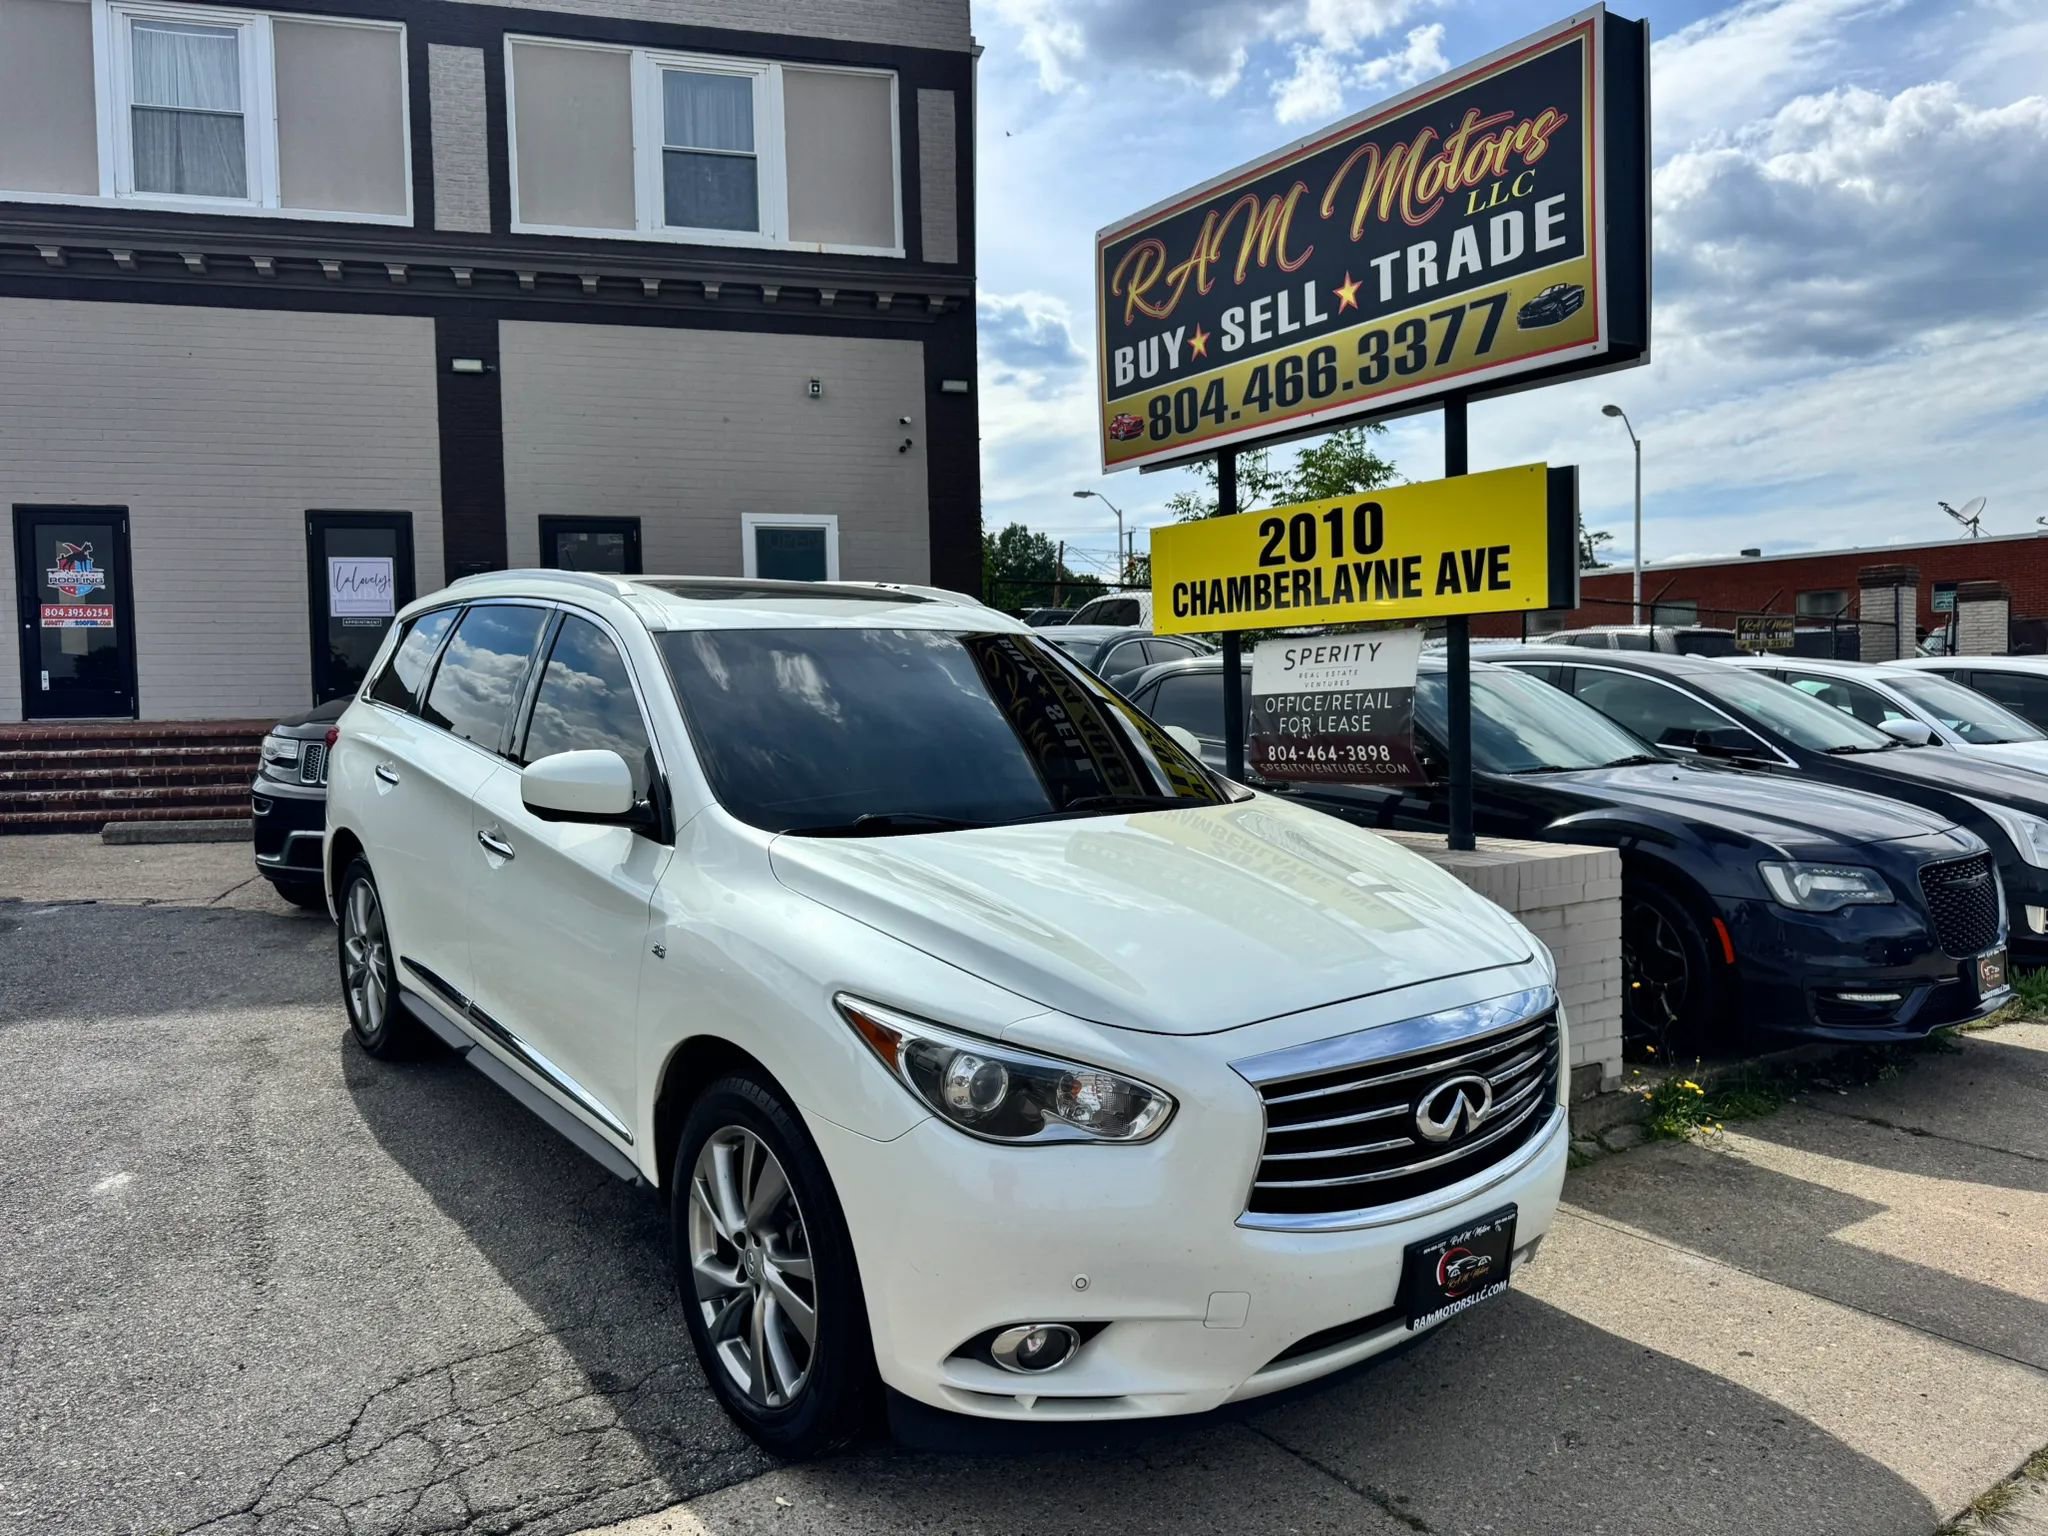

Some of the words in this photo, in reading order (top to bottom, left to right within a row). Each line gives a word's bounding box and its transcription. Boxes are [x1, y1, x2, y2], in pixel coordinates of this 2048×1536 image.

[1464, 168, 1536, 217] LLC
[1111, 182, 1314, 325] RAM
[1320, 107, 1568, 243] Motors
[1114, 326, 1185, 388] BUY
[1220, 280, 1328, 353] SELL
[1370, 193, 1566, 302] TRADE
[1148, 292, 1511, 442] 804.466.3377
[1258, 501, 1384, 567] 2010
[1172, 555, 1423, 618] CHAMBERLAYNE
[1435, 544, 1511, 596] AVE
[1283, 642, 1383, 671] SPERITY
[1299, 671, 1320, 679] REAL
[1326, 669, 1359, 678] ESTATE
[1304, 680, 1351, 689] VENTURES
[1265, 692, 1393, 713] OFFICE/RETAIL
[1279, 717, 1311, 735] FOR
[1318, 715, 1372, 733] LEASE
[1268, 745, 1390, 762] 804-464-3898
[1260, 762, 1410, 775] SPERITYVENTURES.COM
